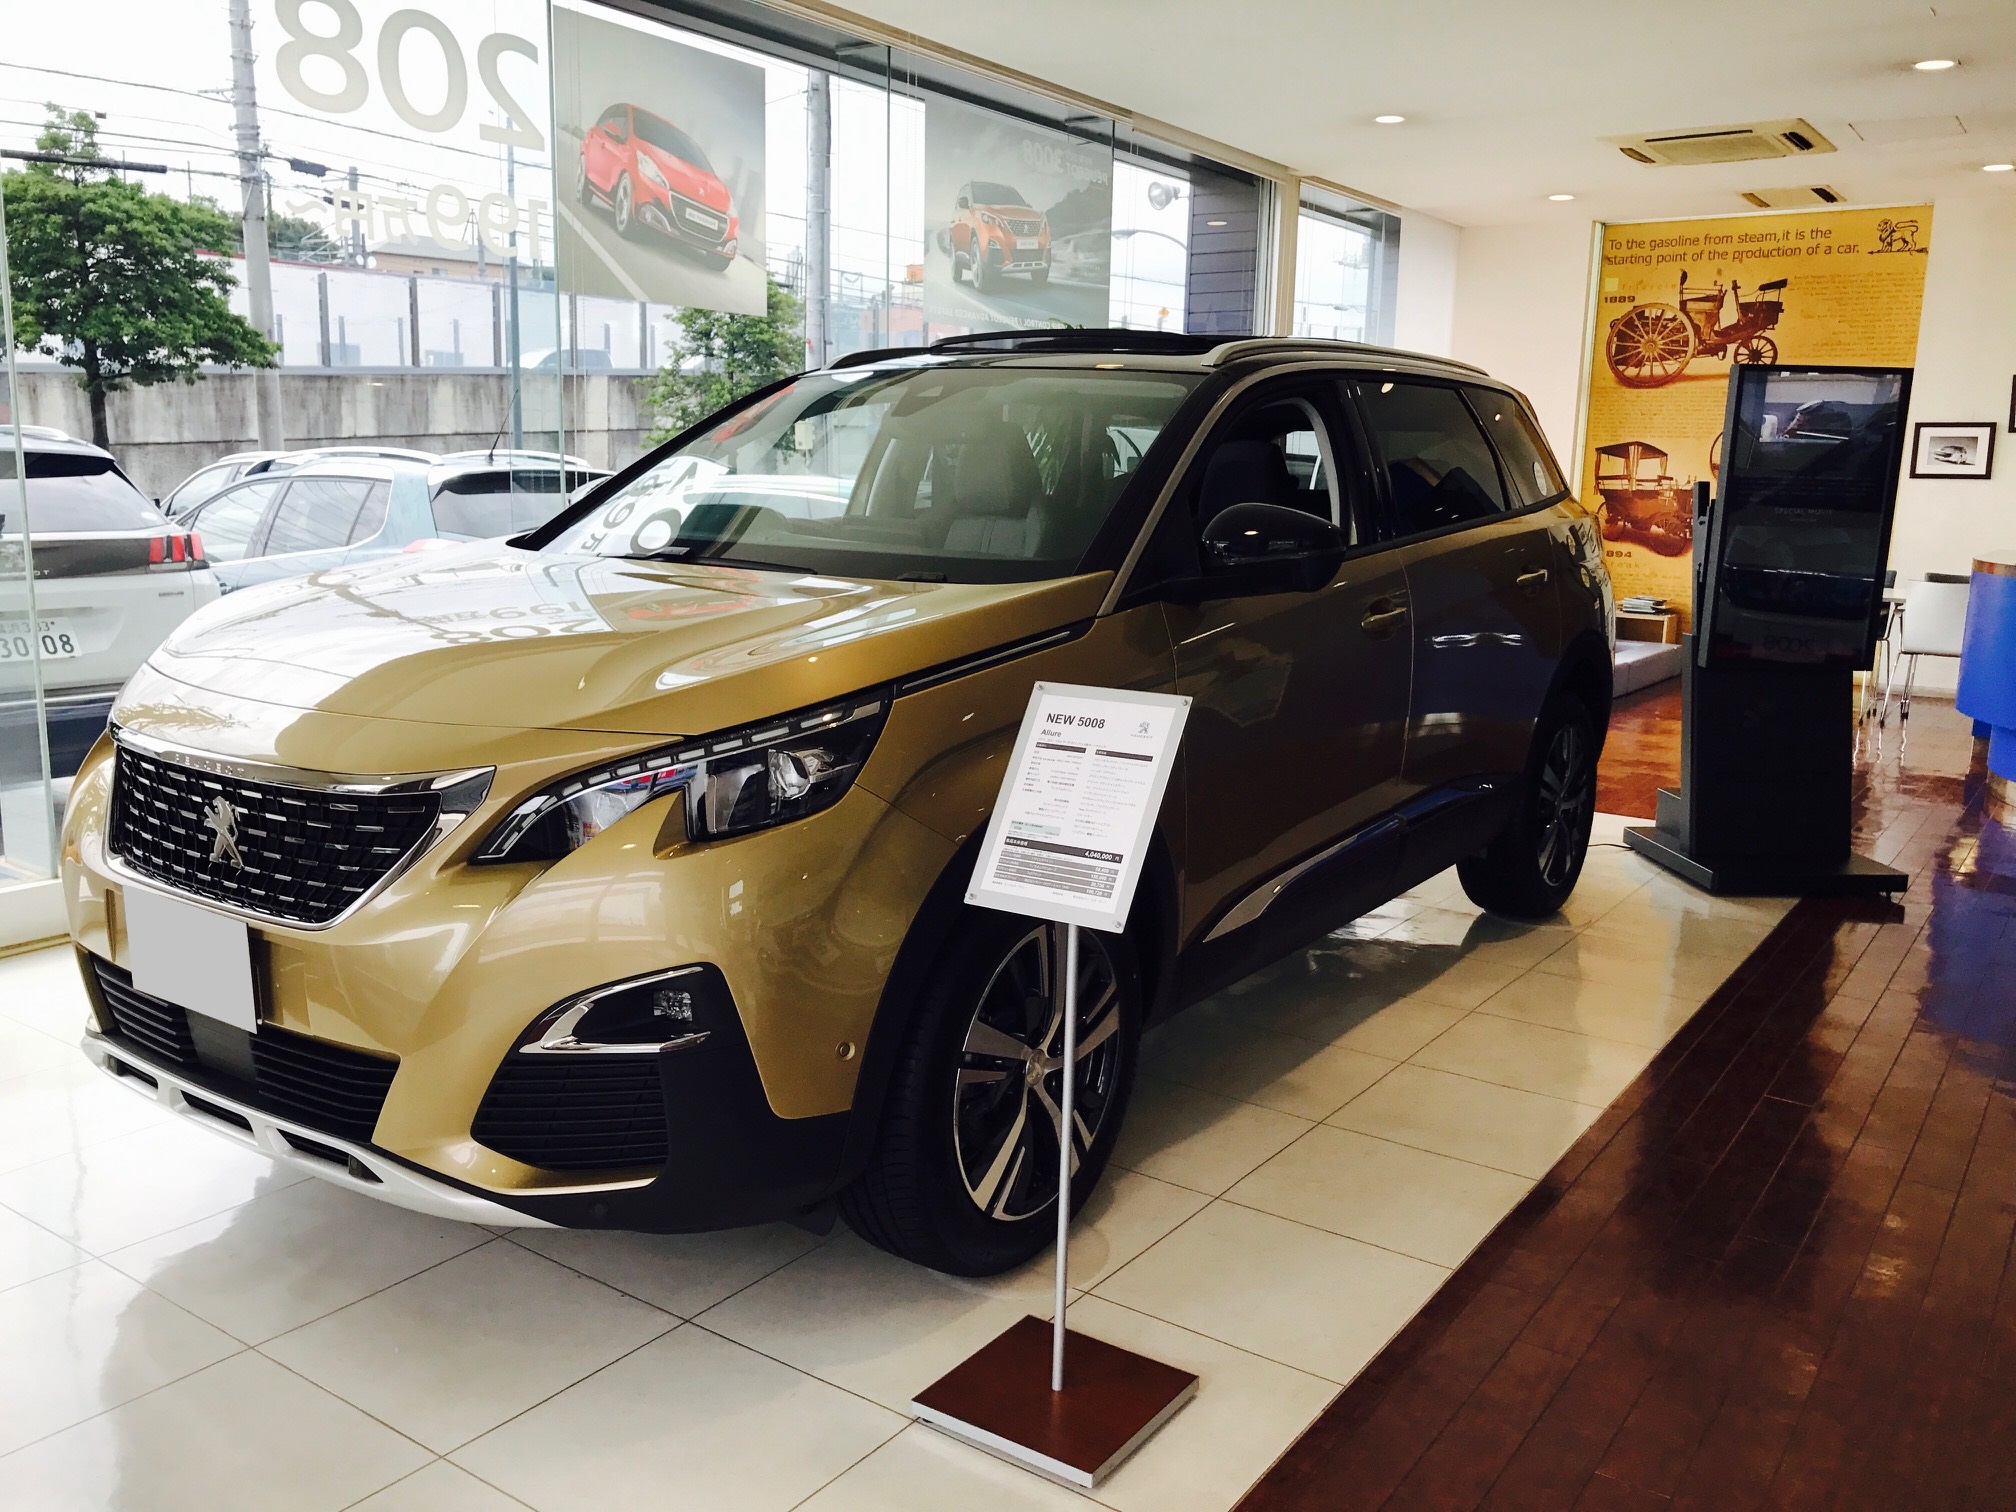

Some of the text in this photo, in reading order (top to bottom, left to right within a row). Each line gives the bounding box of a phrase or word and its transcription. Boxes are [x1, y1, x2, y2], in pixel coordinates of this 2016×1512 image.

[1609, 239, 1623, 250] To
[1626, 238, 1646, 249] the
[1649, 235, 1700, 251] gasoline
[1703, 233, 1733, 246] from
[1795, 230, 1806, 240] is
[1810, 227, 1832, 239] the
[1607, 243, 1860, 267] starting point of the production of a car.
[1604, 295, 1636, 304] 1889
[1605, 549, 1633, 559] 894
[1046, 712, 1106, 729] NEW 5008
[1040, 728, 1062, 738] Allure
[1084, 850, 1113, 861] 4,040,000
